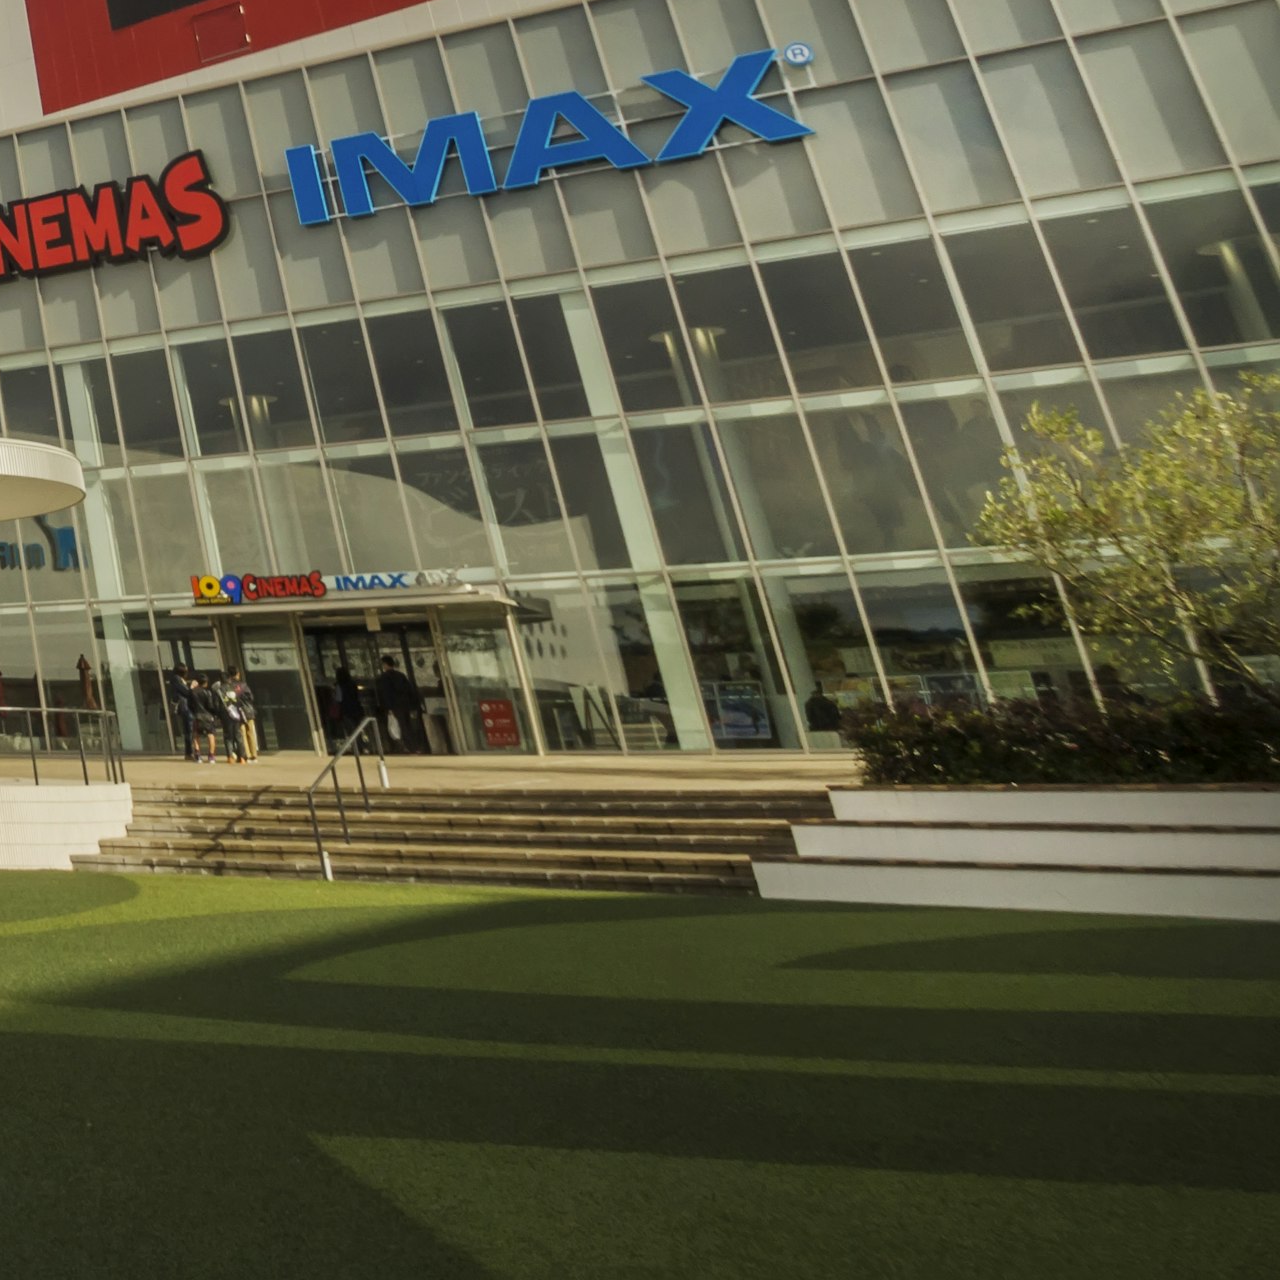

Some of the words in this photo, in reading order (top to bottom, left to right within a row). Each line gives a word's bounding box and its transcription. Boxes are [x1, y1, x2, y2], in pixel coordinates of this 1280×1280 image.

[190, 575, 242, 605] 109
[242, 570, 327, 601] CINEMAS
[335, 573, 411, 592] IMAX
